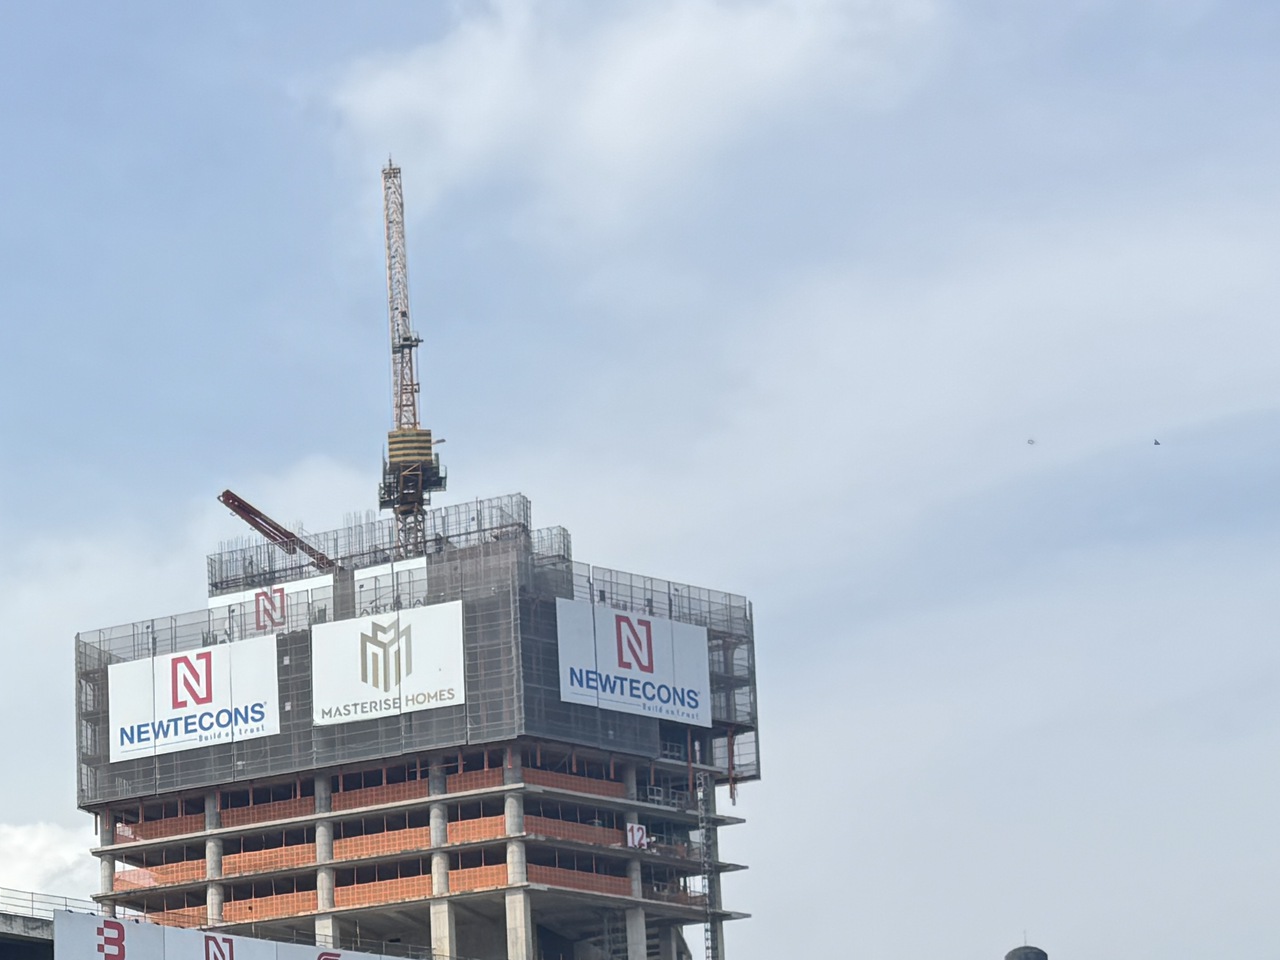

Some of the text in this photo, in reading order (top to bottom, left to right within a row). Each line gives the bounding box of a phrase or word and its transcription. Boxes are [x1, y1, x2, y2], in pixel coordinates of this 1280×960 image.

[570, 667, 700, 710] NEWTECONS
[321, 688, 455, 719] MASTERISE HOMES
[642, 703, 663, 714] Build
[675, 708, 700, 720] trust
[119, 702, 266, 747] NEWTECONS
[198, 731, 222, 743] Build
[239, 724, 265, 735] trust
[628, 825, 646, 847] 12
